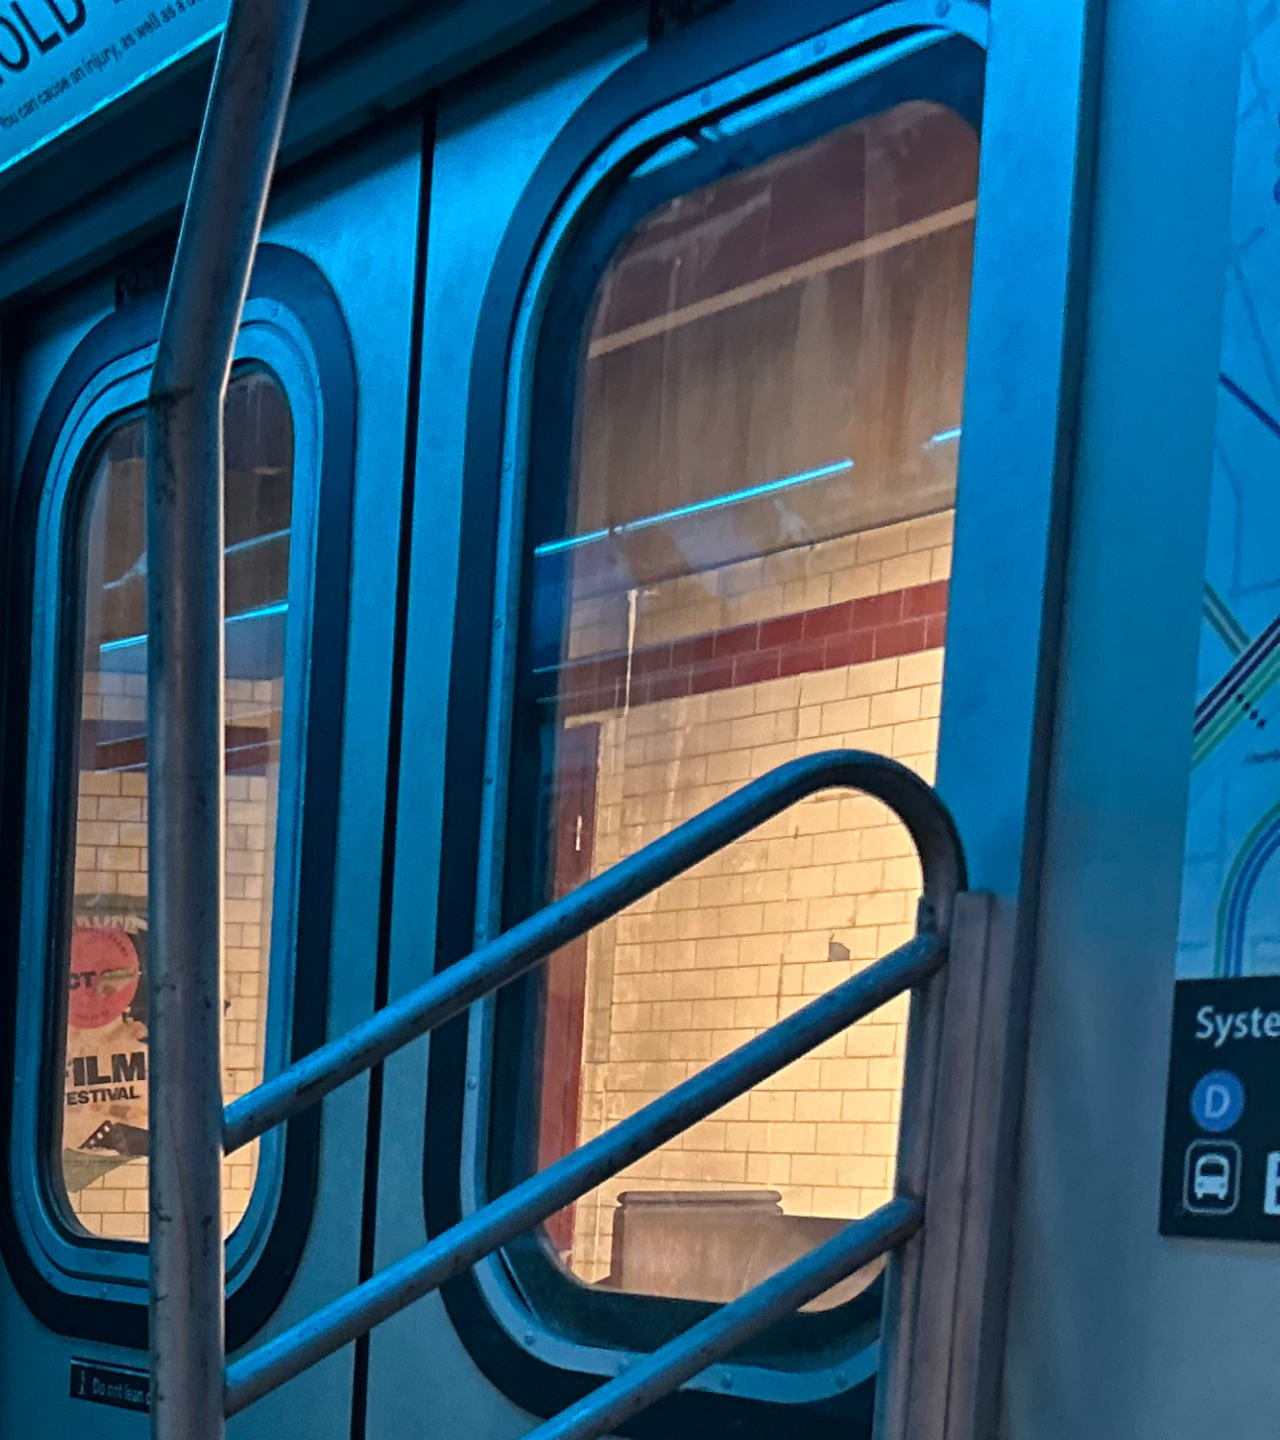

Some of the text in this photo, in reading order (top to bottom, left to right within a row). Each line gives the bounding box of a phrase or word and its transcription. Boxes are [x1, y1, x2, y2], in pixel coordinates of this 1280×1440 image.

[17, 99, 39, 119] can
[38, 79, 70, 107] cause
[70, 66, 88, 85] an
[120, 34, 137, 50] as
[136, 16, 162, 41] well
[66, 1052, 146, 1087] ILM
[64, 1086, 141, 1106] ESTIVAL
[1204, 1084, 1231, 1118] D
